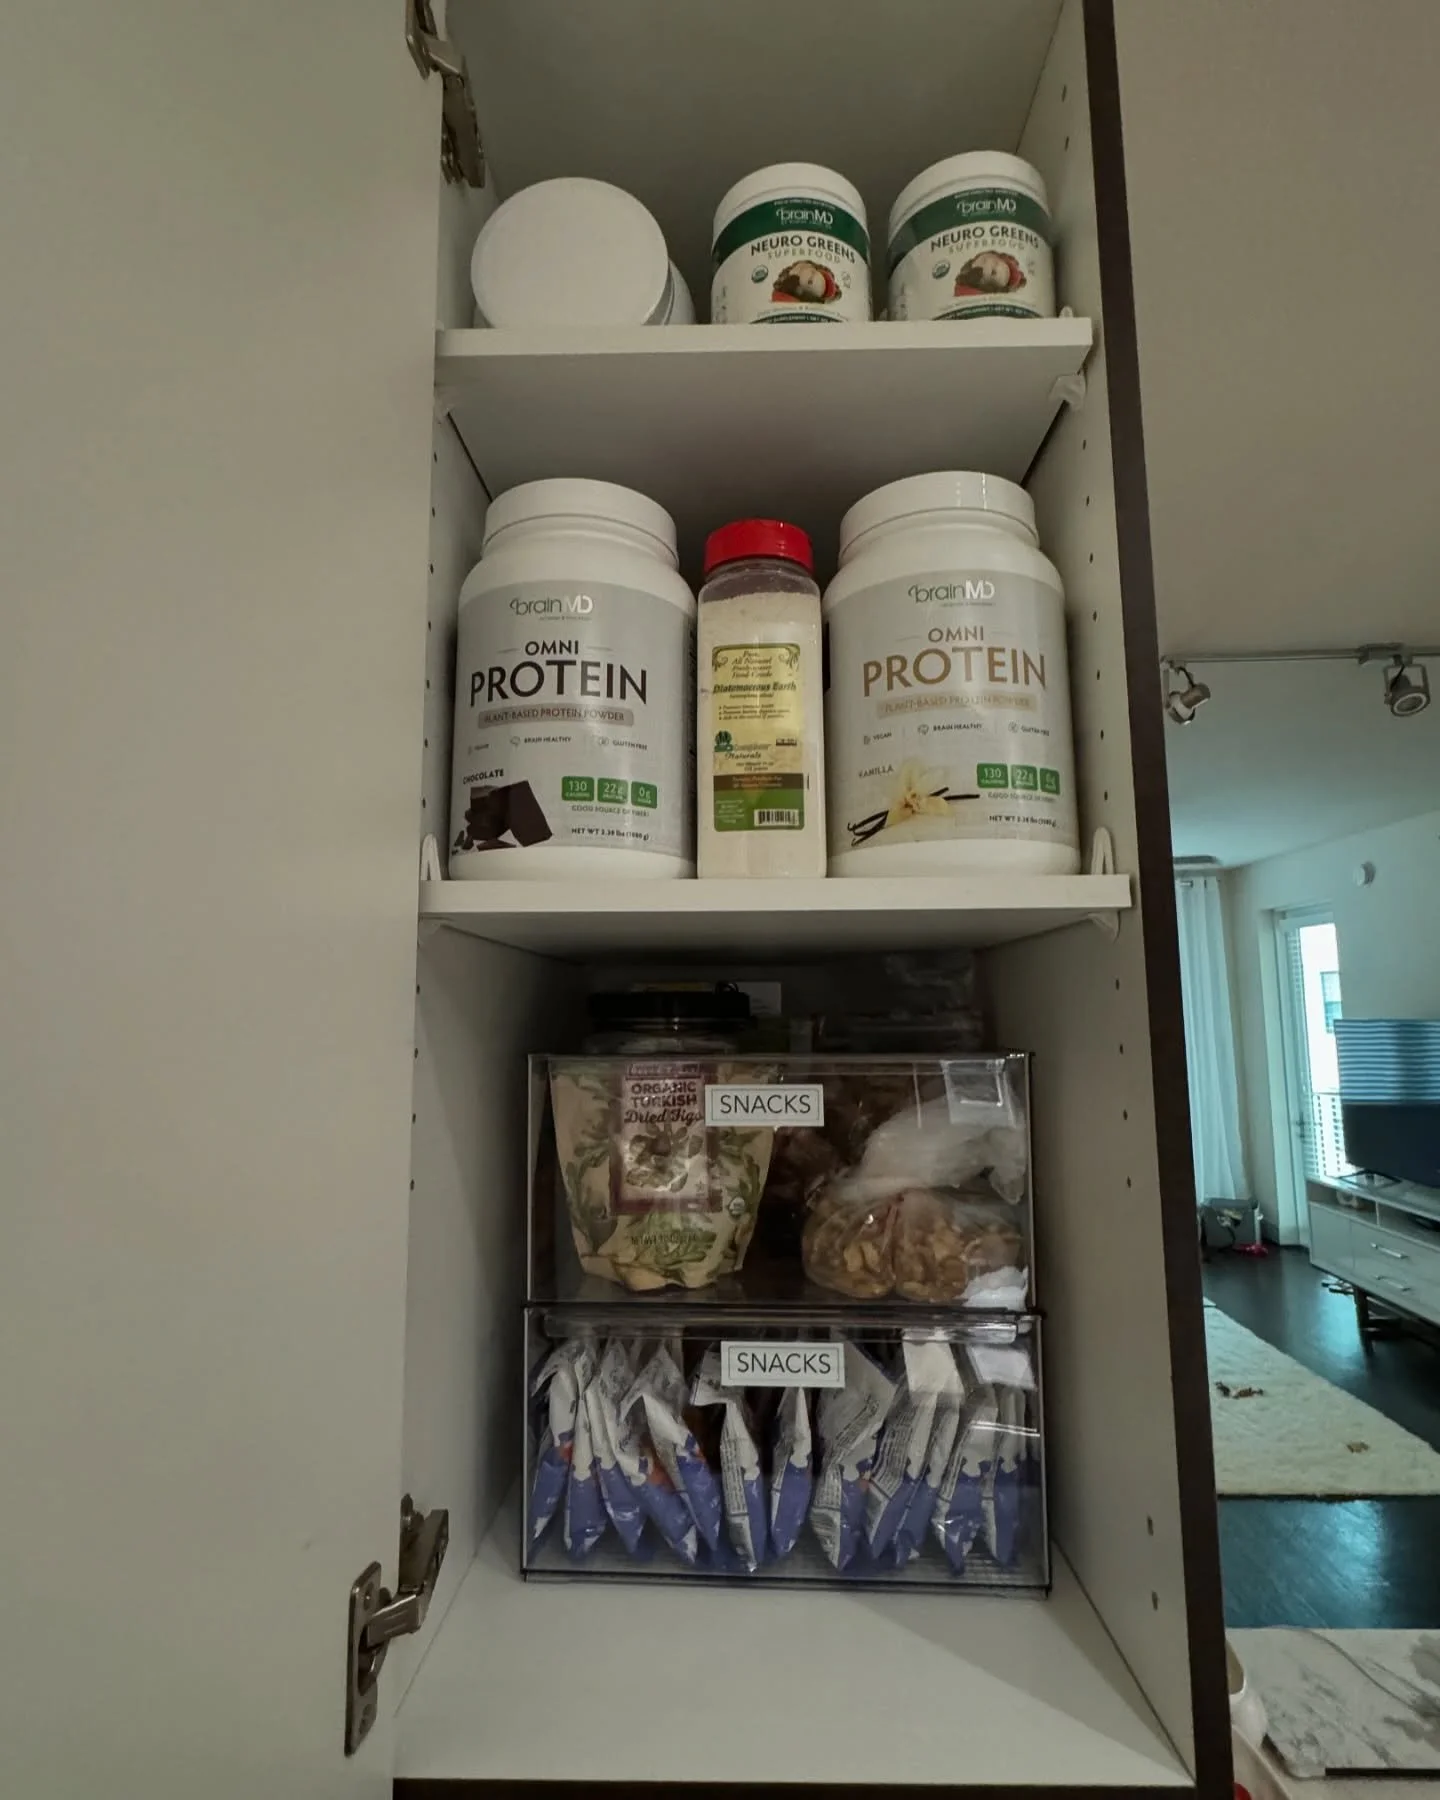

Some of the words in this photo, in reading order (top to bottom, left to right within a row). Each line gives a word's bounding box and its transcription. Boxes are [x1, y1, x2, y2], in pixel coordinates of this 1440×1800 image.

[930, 226, 986, 253] NEURO
[989, 225, 1040, 249] GREENS
[750, 234, 803, 257] NEURO
[806, 235, 856, 264] GREENS
[767, 248, 841, 264] SUPERFOOD
[928, 625, 985, 643] OMNI
[524, 639, 580, 656] OMNI
[863, 646, 1047, 697] PROTEIN
[470, 659, 648, 707] PROTEIN
[540, 707, 583, 719] PROTEIN
[542, 735, 572, 743] HEALTHY
[463, 768, 505, 785] CHOCOLATE
[858, 764, 895, 779] VANILLA
[983, 767, 1001, 779] 130
[568, 779, 588, 792] 130
[571, 827, 586, 835] NET
[587, 828, 600, 836] WT
[631, 1080, 697, 1095] ORGANIC
[630, 1095, 698, 1109] TURKISH
[719, 1094, 812, 1115] SNACKS
[624, 1108, 666, 1125] Dried
[736, 1352, 833, 1375] SNACKS
